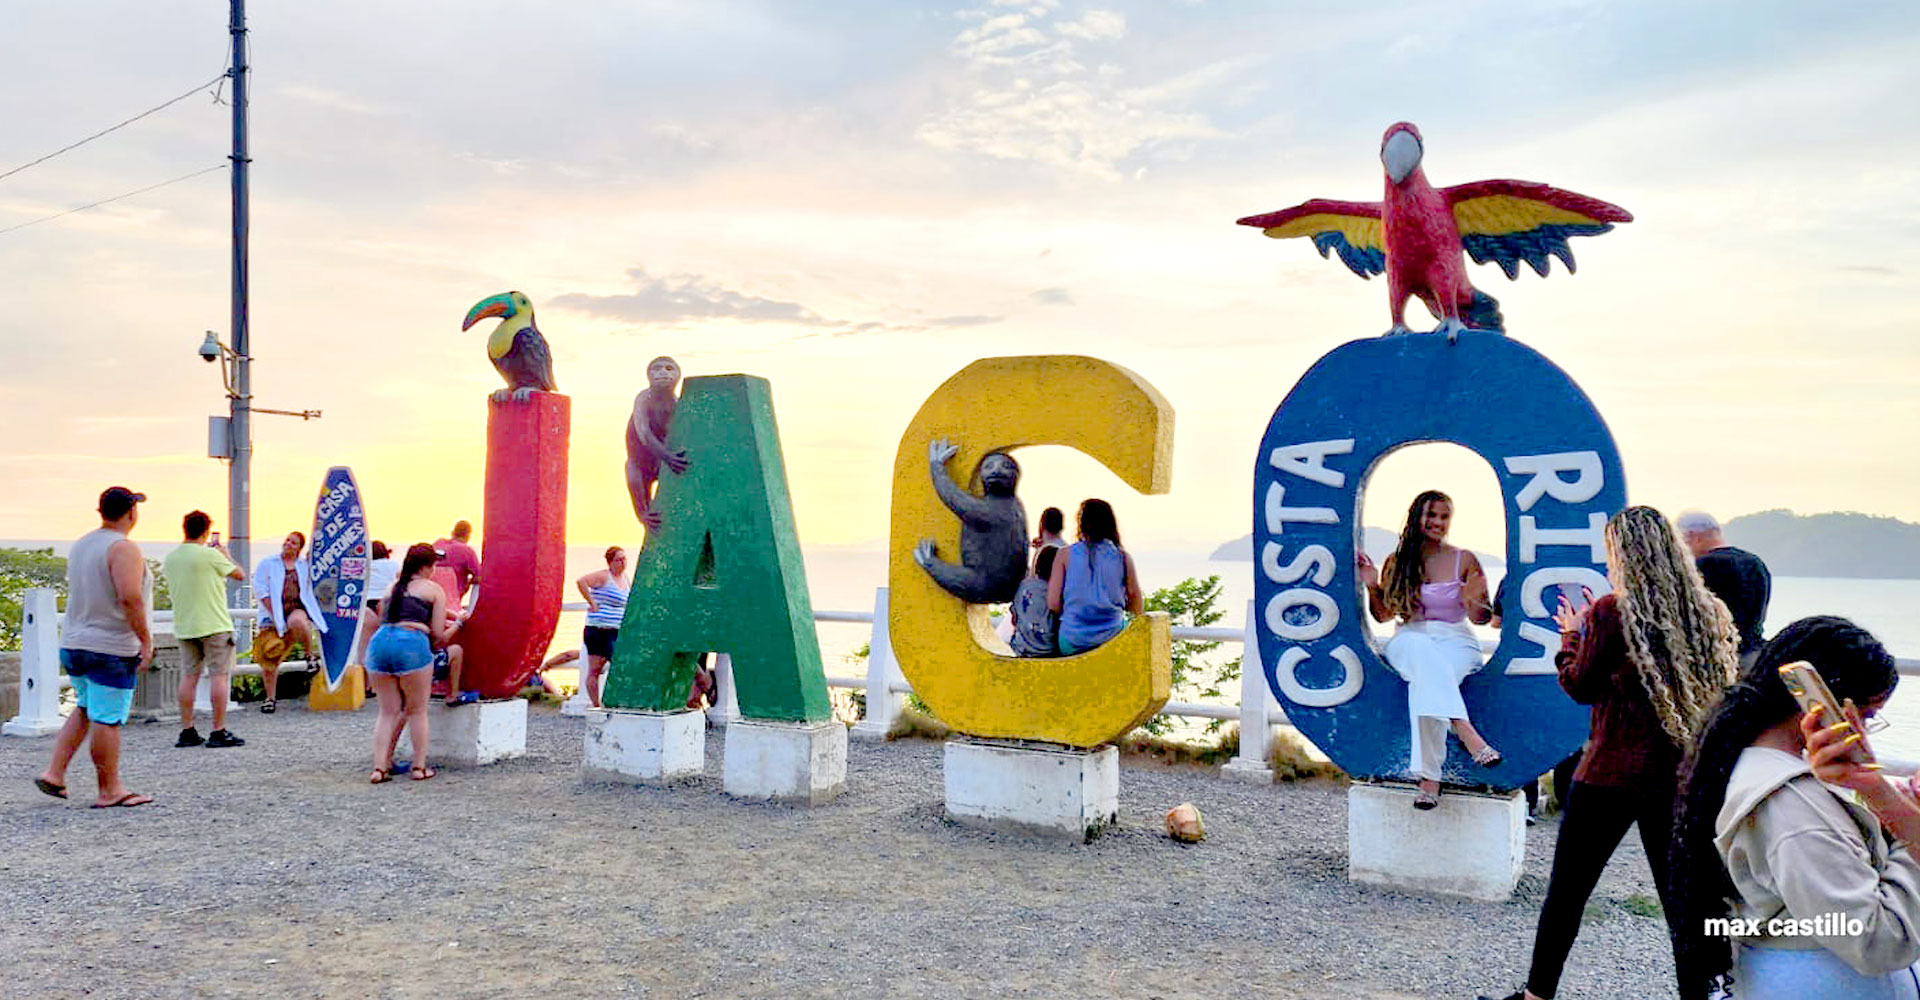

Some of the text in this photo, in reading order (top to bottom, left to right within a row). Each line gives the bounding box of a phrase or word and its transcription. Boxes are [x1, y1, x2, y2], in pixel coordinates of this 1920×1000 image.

[318, 482, 354, 519] CASA
[325, 511, 347, 539] DE
[310, 521, 364, 581] CAMPEONES
[1262, 438, 1364, 707] COSTA
